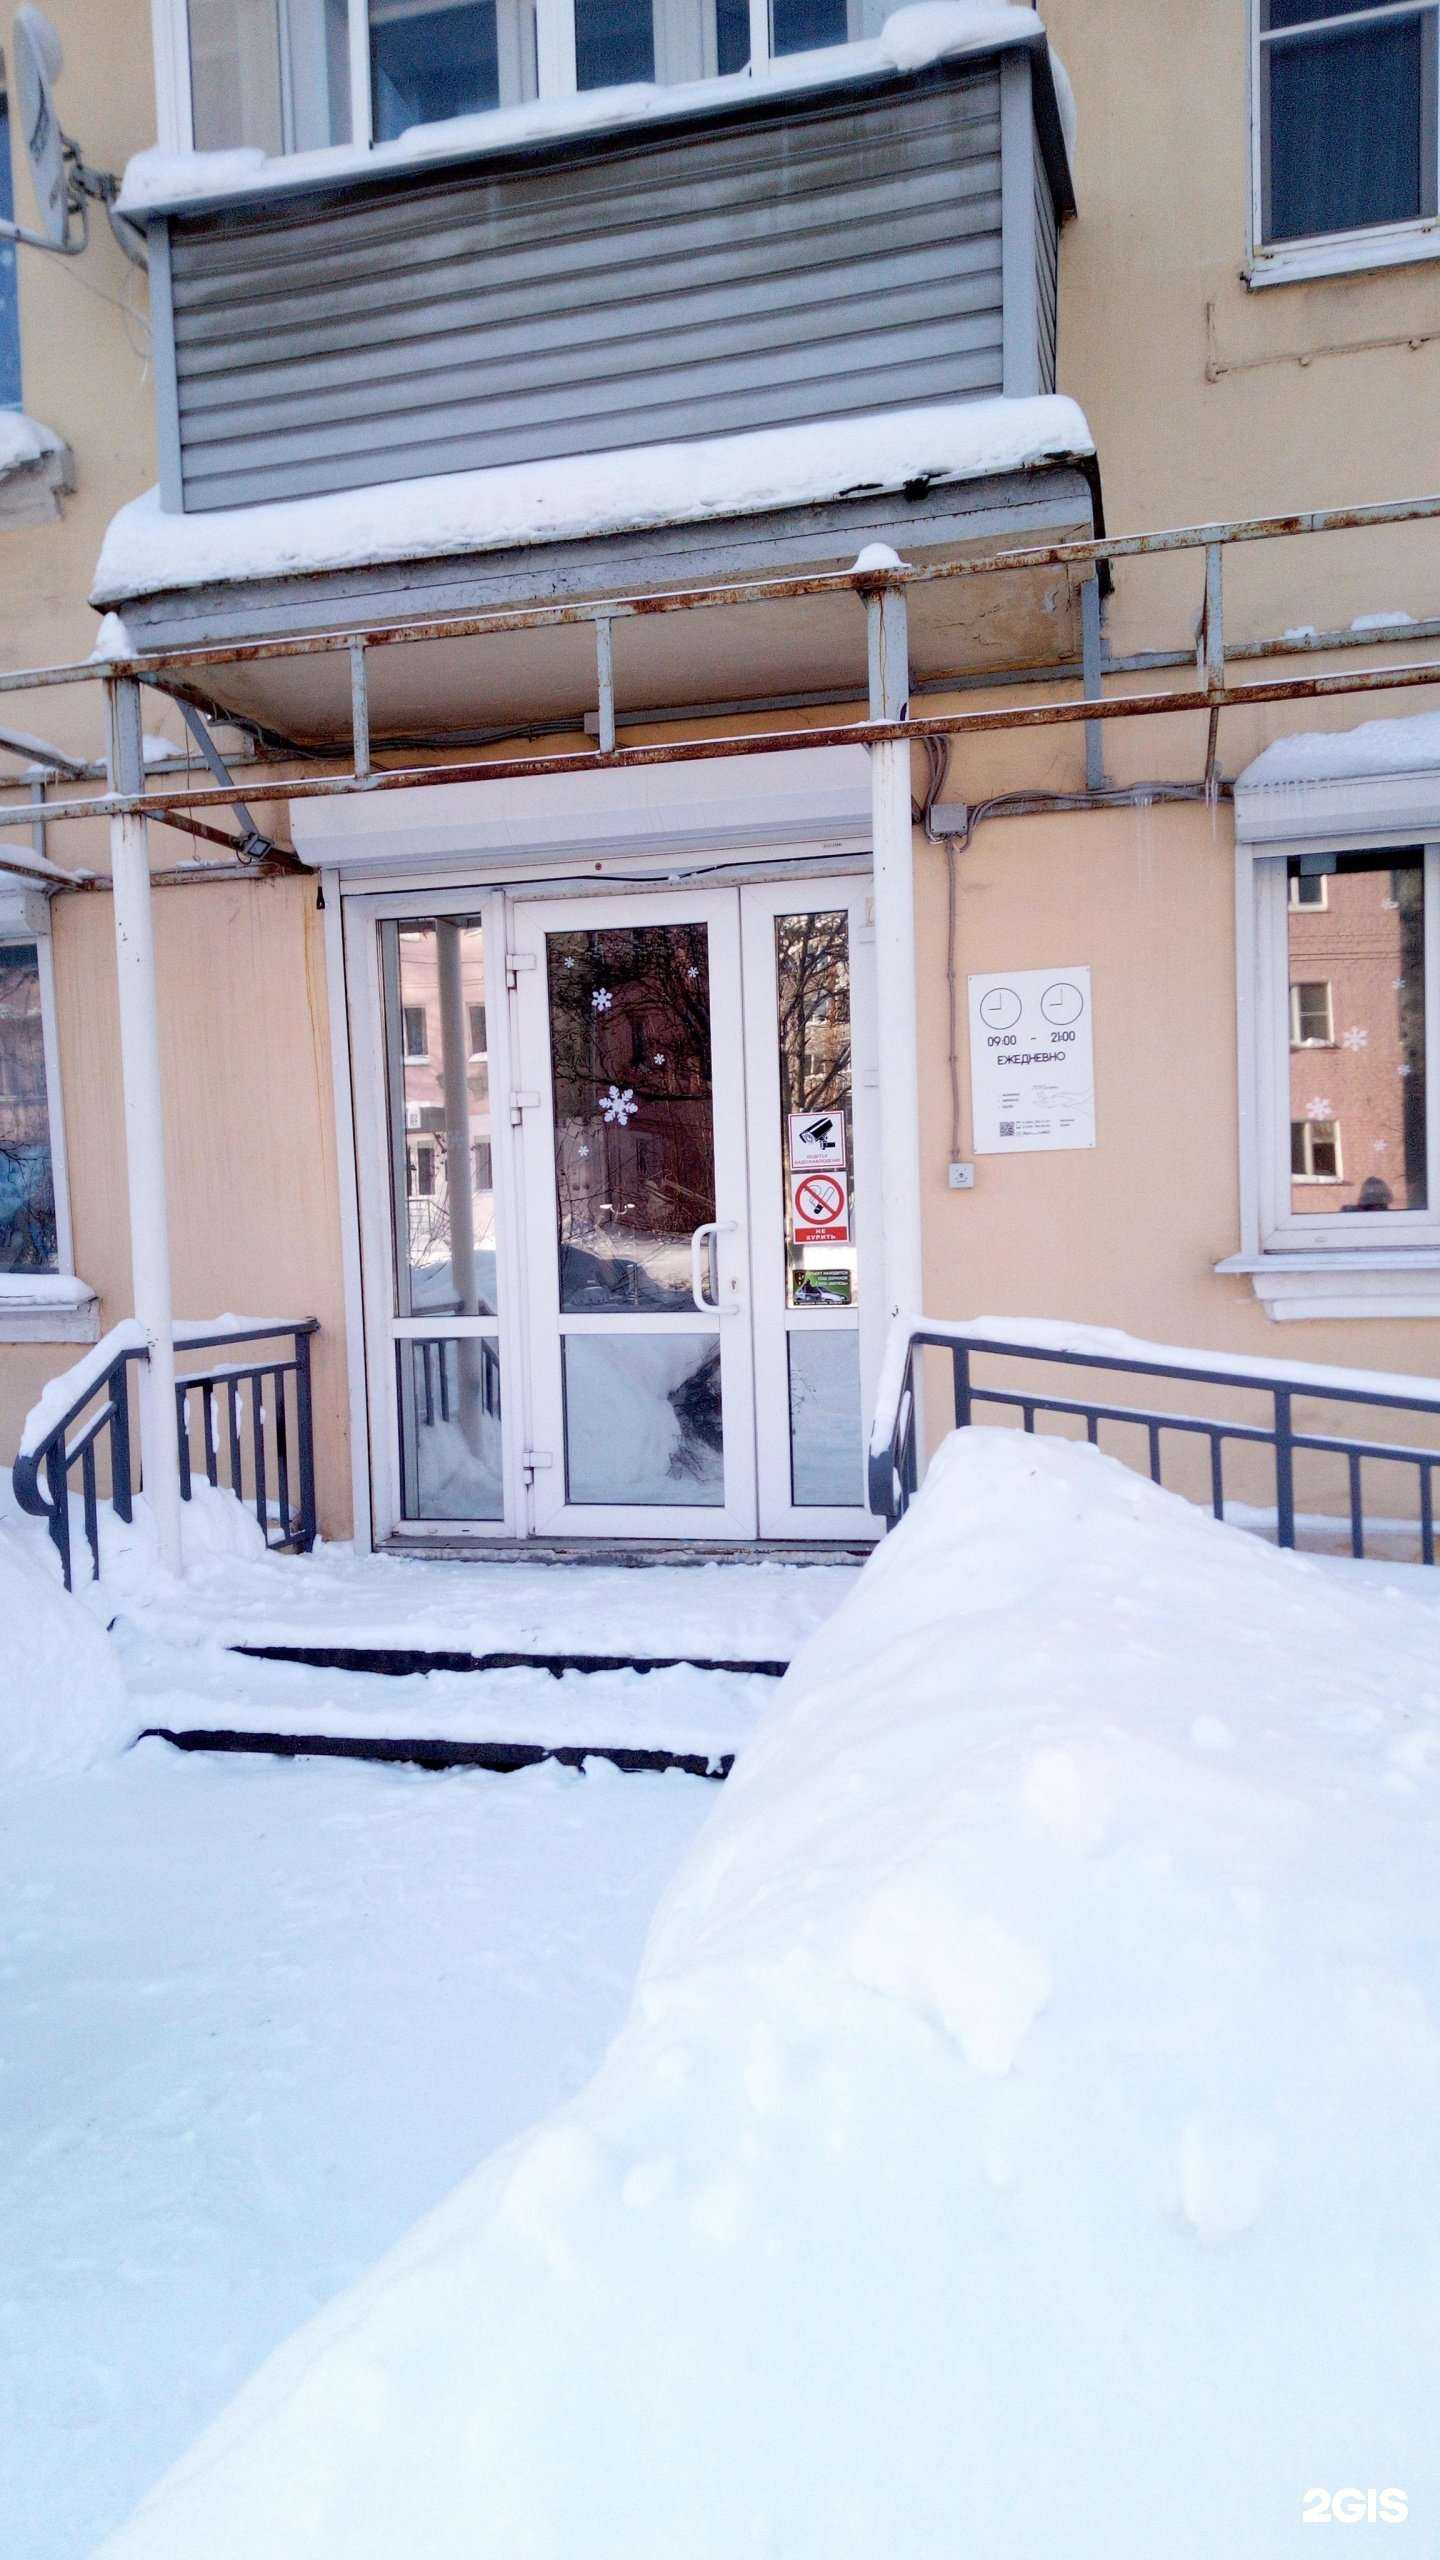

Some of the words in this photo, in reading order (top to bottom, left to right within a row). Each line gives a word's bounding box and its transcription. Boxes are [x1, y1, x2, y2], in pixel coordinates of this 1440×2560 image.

[987, 1035, 1017, 1047] 09:00
[1050, 1031, 1076, 1043] 21:00
[997, 1051, 1066, 1065] ЕЖЕДНЕВНО
